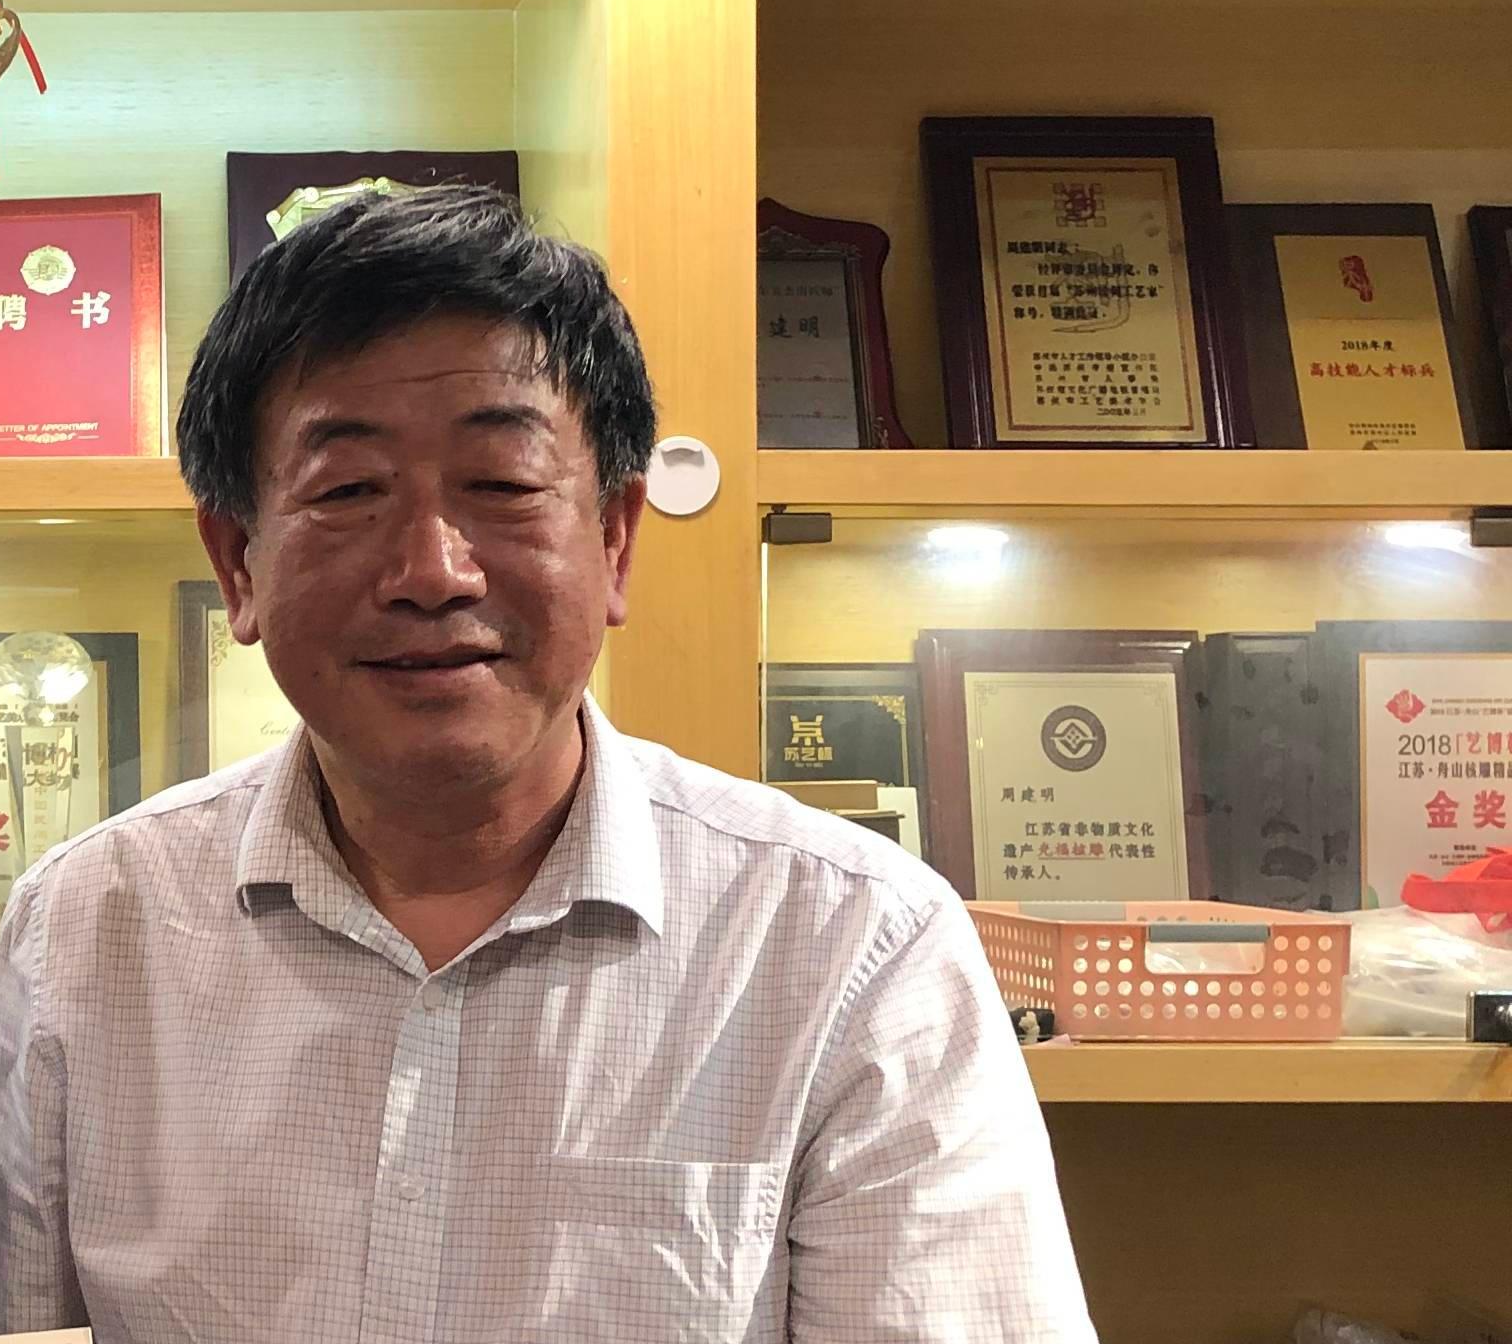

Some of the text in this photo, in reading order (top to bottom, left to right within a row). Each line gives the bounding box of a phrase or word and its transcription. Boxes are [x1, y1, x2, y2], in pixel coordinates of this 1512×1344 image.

[1310, 362, 1435, 378] 高技能人才标兵
[27, 424, 39, 432] OF
[41, 422, 99, 432] APPOINTMENT
[1001, 787, 1055, 803] 周建明
[1425, 790, 1507, 829] 金奖
[1025, 822, 1155, 837] 江苏省非物质文化
